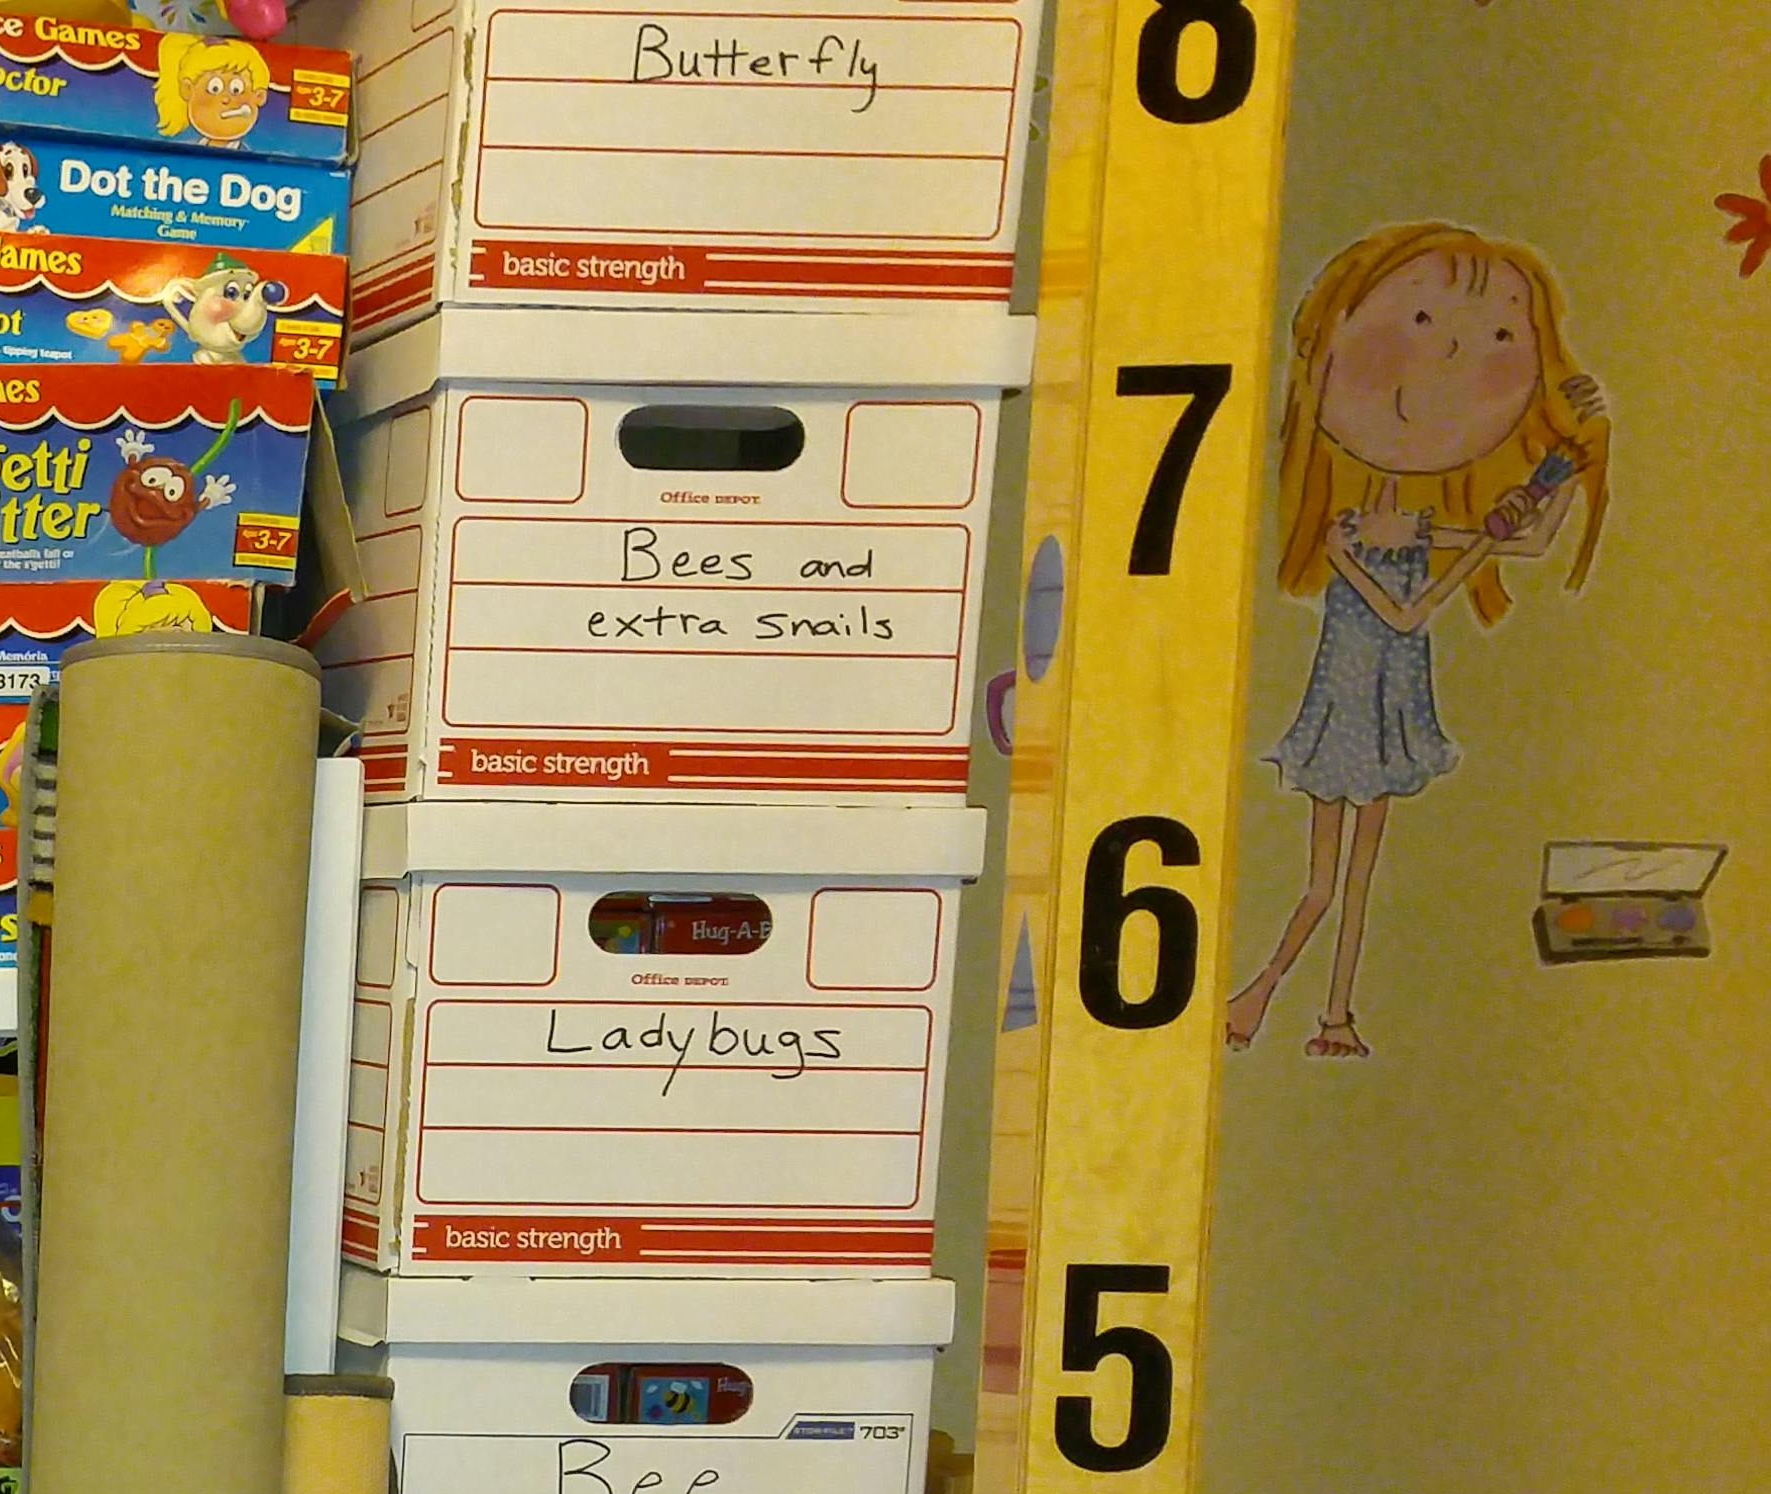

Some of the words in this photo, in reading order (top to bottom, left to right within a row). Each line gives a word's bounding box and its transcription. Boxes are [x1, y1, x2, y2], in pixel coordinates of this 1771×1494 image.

[630, 24, 880, 113] Butterfly
[1135, 0, 1257, 125] 8
[60, 159, 132, 201] Dot
[141, 166, 210, 205] the
[219, 171, 303, 220] Dog
[502, 251, 570, 279] basic
[576, 255, 685, 286] strength
[660, 492, 710, 505] Office
[714, 495, 760, 505] DEPOT
[1116, 362, 1233, 578] 7
[253, 528, 292, 551] 3-7
[620, 527, 754, 582] Bees
[799, 550, 874, 579] and
[588, 606, 728, 640] extra
[471, 749, 537, 776] basic
[543, 750, 650, 779] strength
[1076, 816, 1199, 1032] 6
[546, 1008, 842, 1097] Ladybugs
[445, 1224, 511, 1250] basic
[516, 1227, 622, 1255] strength
[1054, 1262, 1174, 1475] 5
